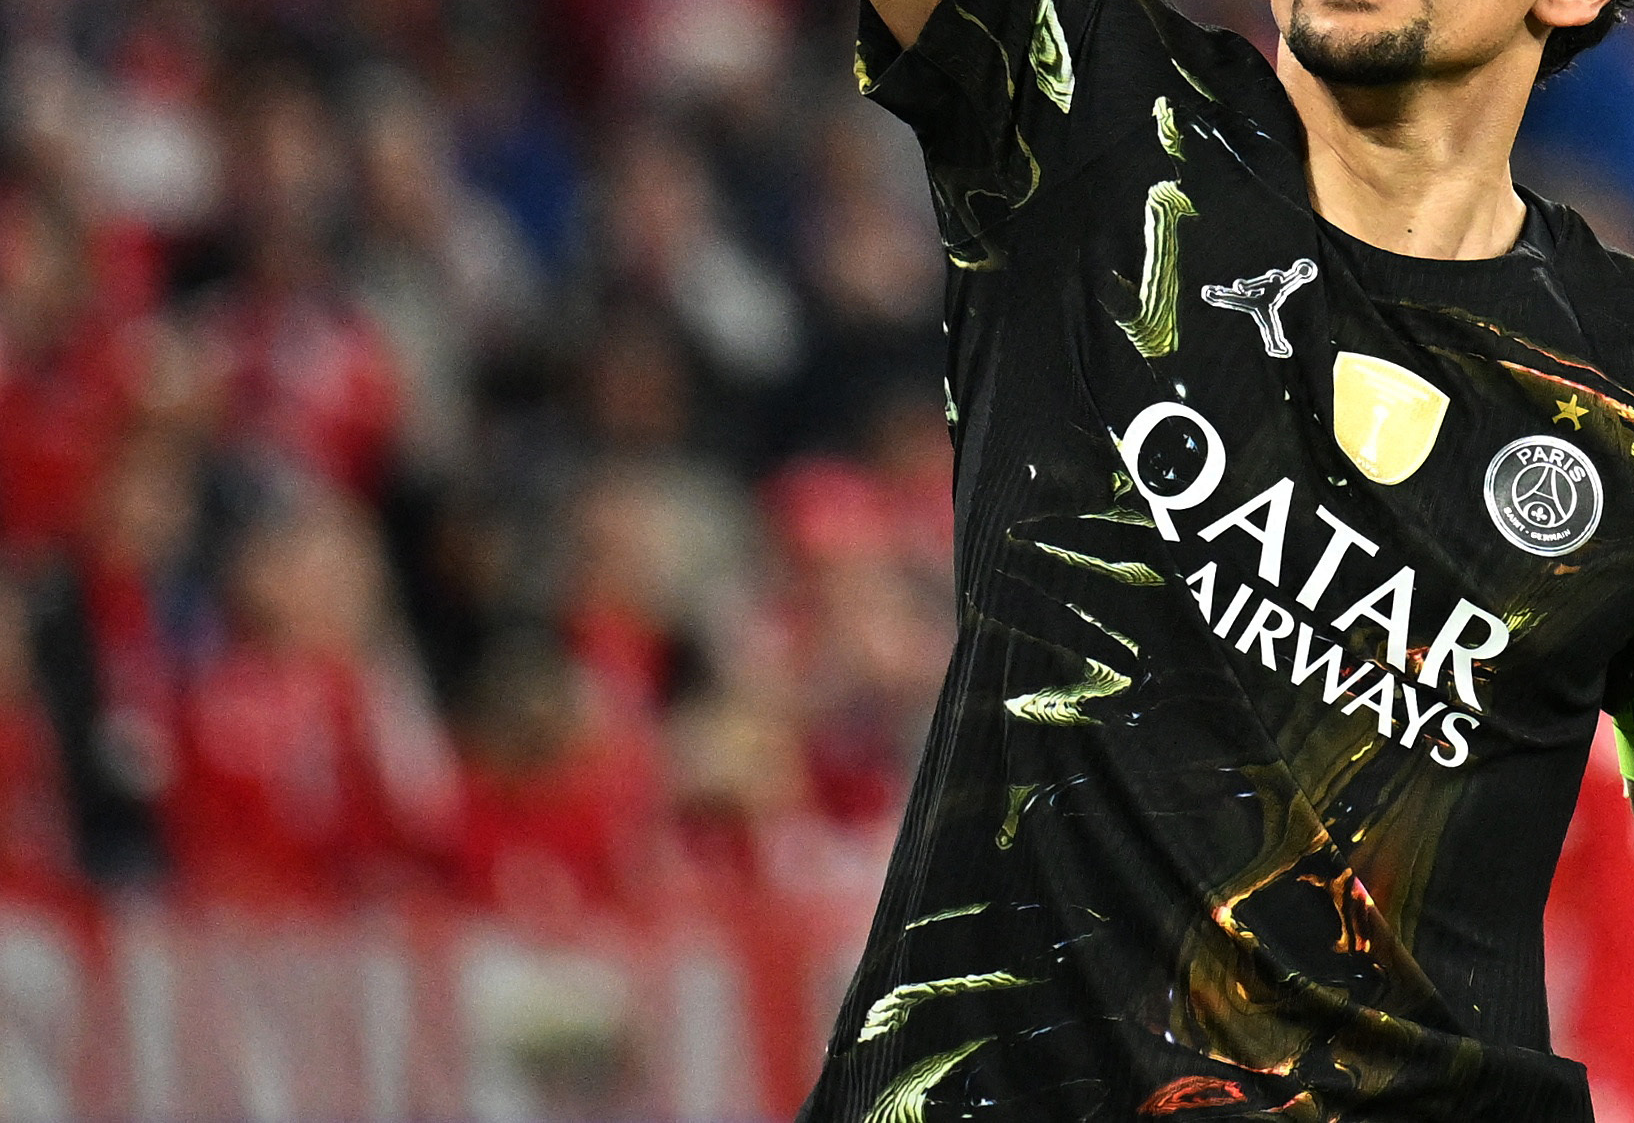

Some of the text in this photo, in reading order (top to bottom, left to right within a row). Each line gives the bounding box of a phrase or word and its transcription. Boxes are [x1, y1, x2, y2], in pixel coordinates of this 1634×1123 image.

[1120, 402, 1509, 708] QATAR
[1516, 446, 1587, 483] PARIS
[1185, 561, 1480, 768] AIRWAYS
